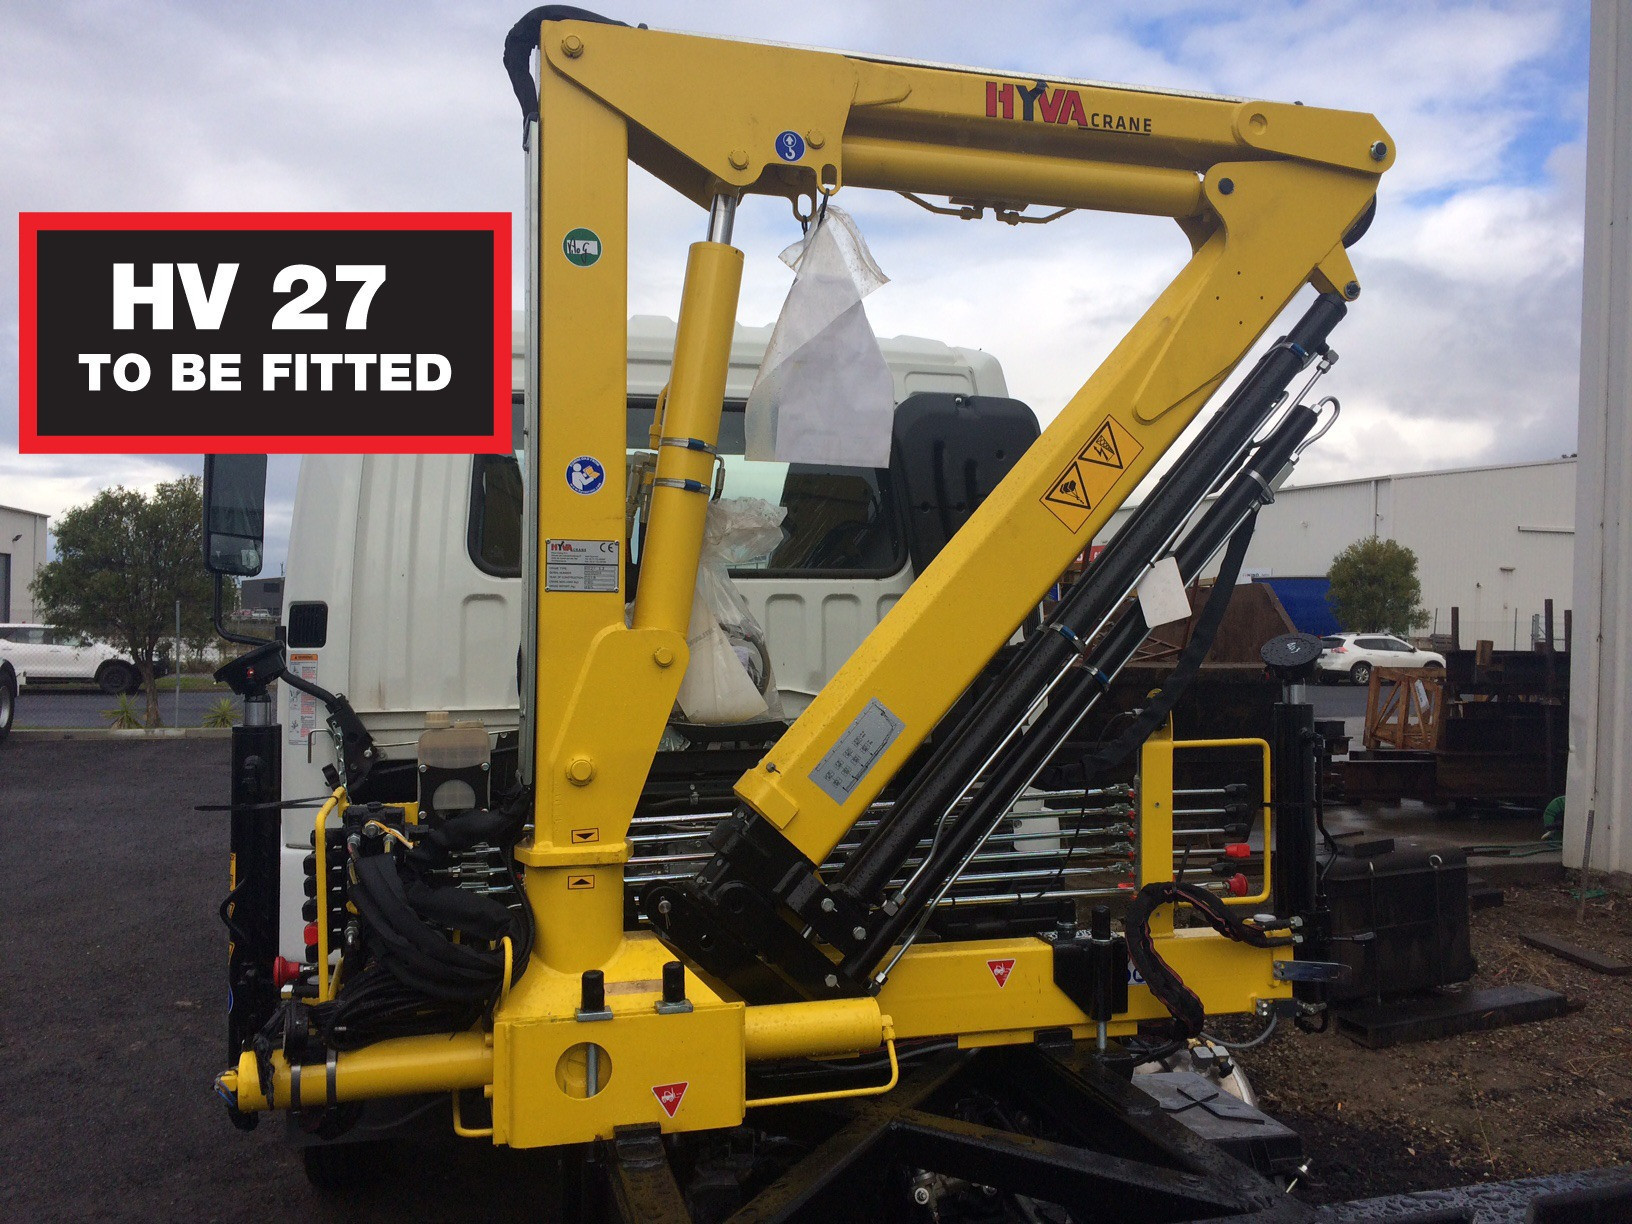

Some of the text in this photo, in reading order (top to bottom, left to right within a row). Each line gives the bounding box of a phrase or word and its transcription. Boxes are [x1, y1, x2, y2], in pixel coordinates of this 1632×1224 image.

[986, 79, 1152, 133] HYVA CRANE
[551, 541, 573, 552] HYVA
